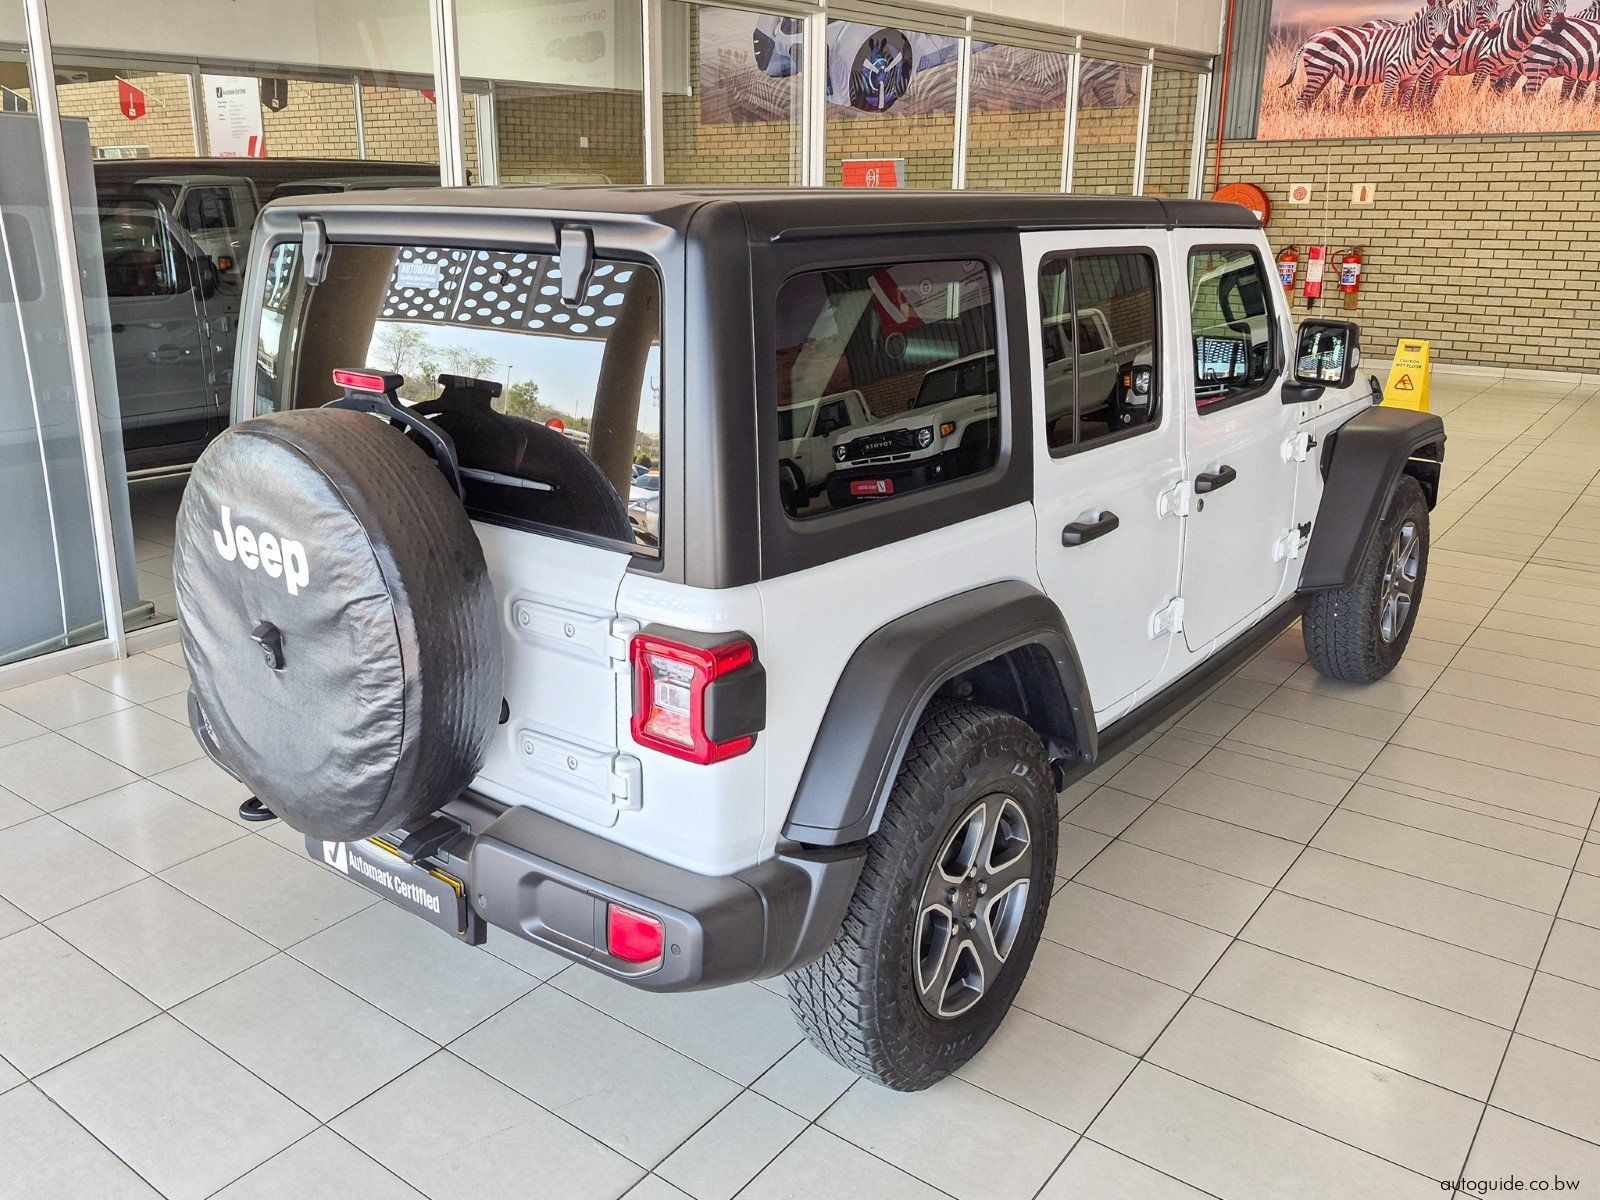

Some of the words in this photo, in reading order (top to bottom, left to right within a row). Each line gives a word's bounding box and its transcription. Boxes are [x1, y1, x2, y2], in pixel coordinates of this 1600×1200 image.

[400, 264, 437, 275] AUTOMARK
[212, 505, 310, 596] Jeep
[348, 850, 394, 891] Automark
[393, 875, 441, 914] Certified
